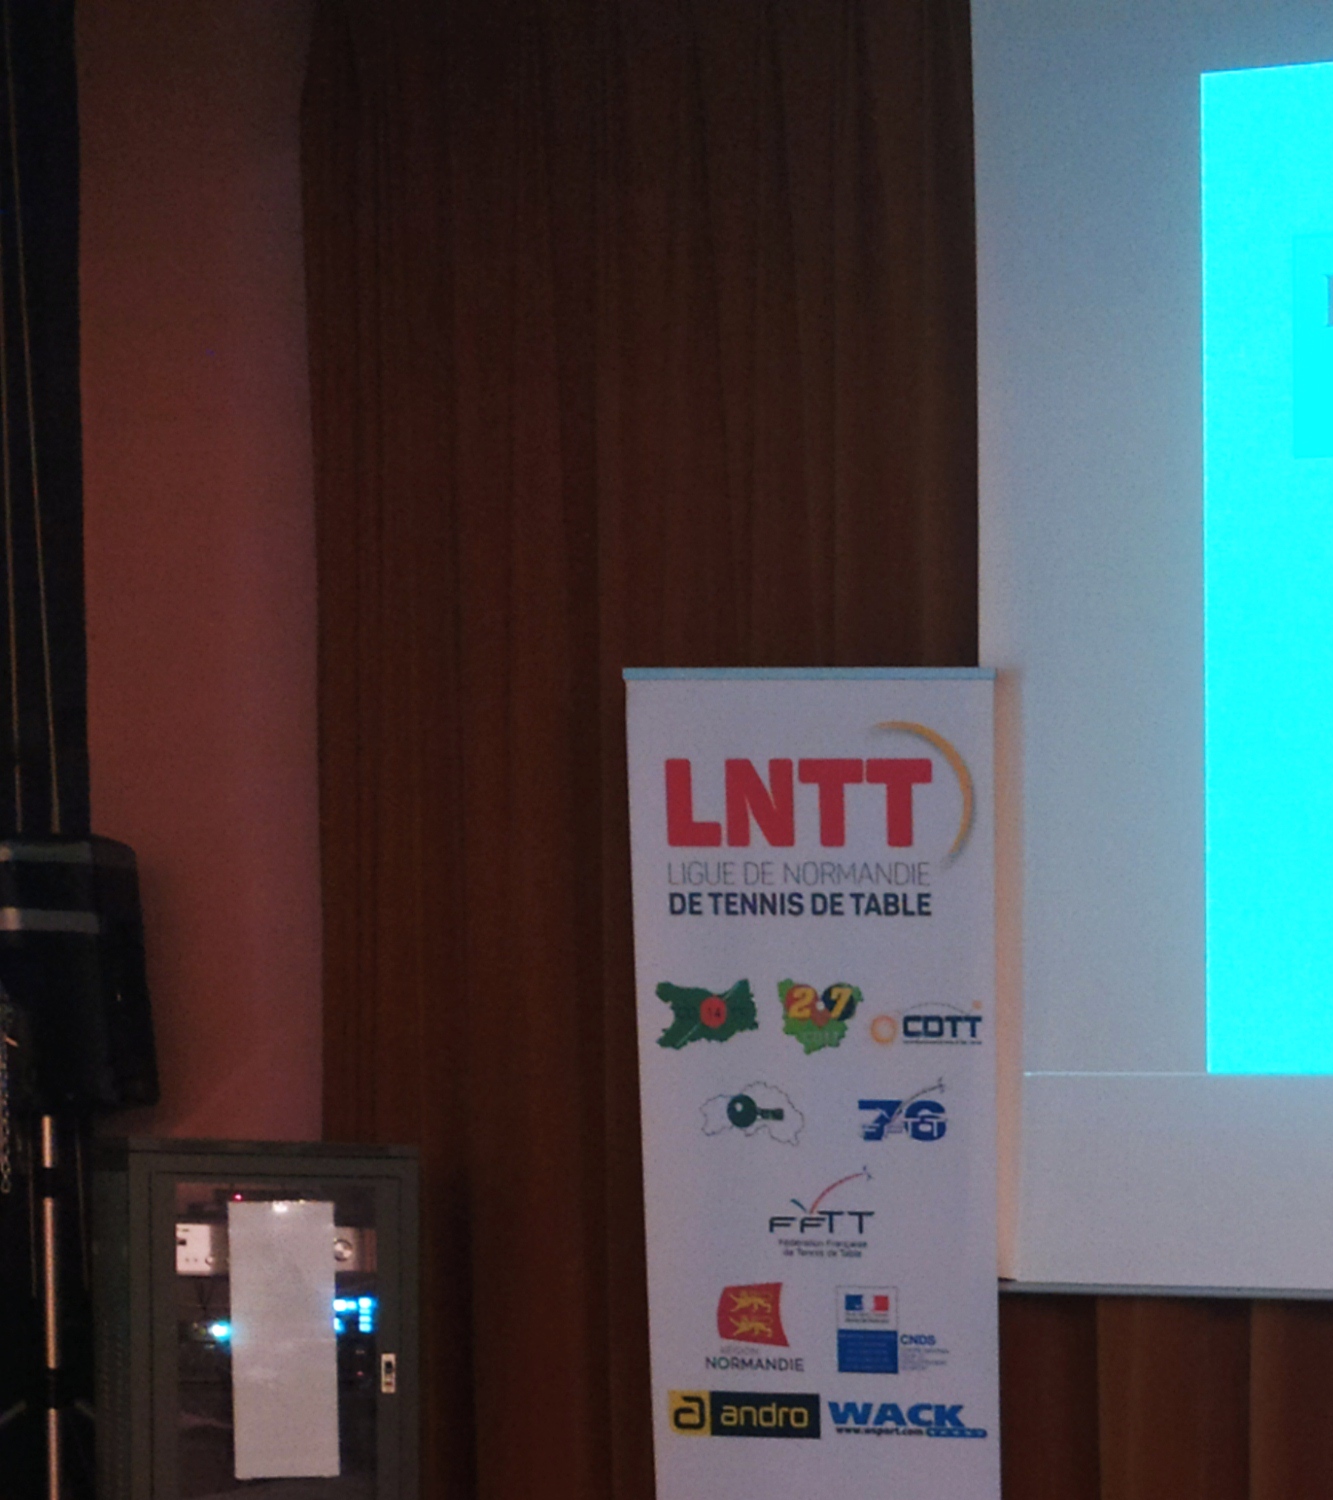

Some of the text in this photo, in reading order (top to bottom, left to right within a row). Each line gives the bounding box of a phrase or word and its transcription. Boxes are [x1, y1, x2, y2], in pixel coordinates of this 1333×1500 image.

[665, 758, 932, 847] LNTT
[667, 861, 931, 887] LIGUE DE NORMANDIE
[669, 892, 932, 917] DE TENNIS DE TABLE
[787, 985, 853, 1020] 27
[902, 1015, 983, 1039] CDTT
[858, 1099, 948, 1142] 76
[769, 1210, 876, 1235] FFTT
[900, 1333, 937, 1346] CNDS
[705, 1356, 805, 1373] NORMANDIE
[720, 1404, 809, 1429] andro
[828, 1401, 966, 1427] WACK
[836, 1427, 924, 1437] www.wsport.com
